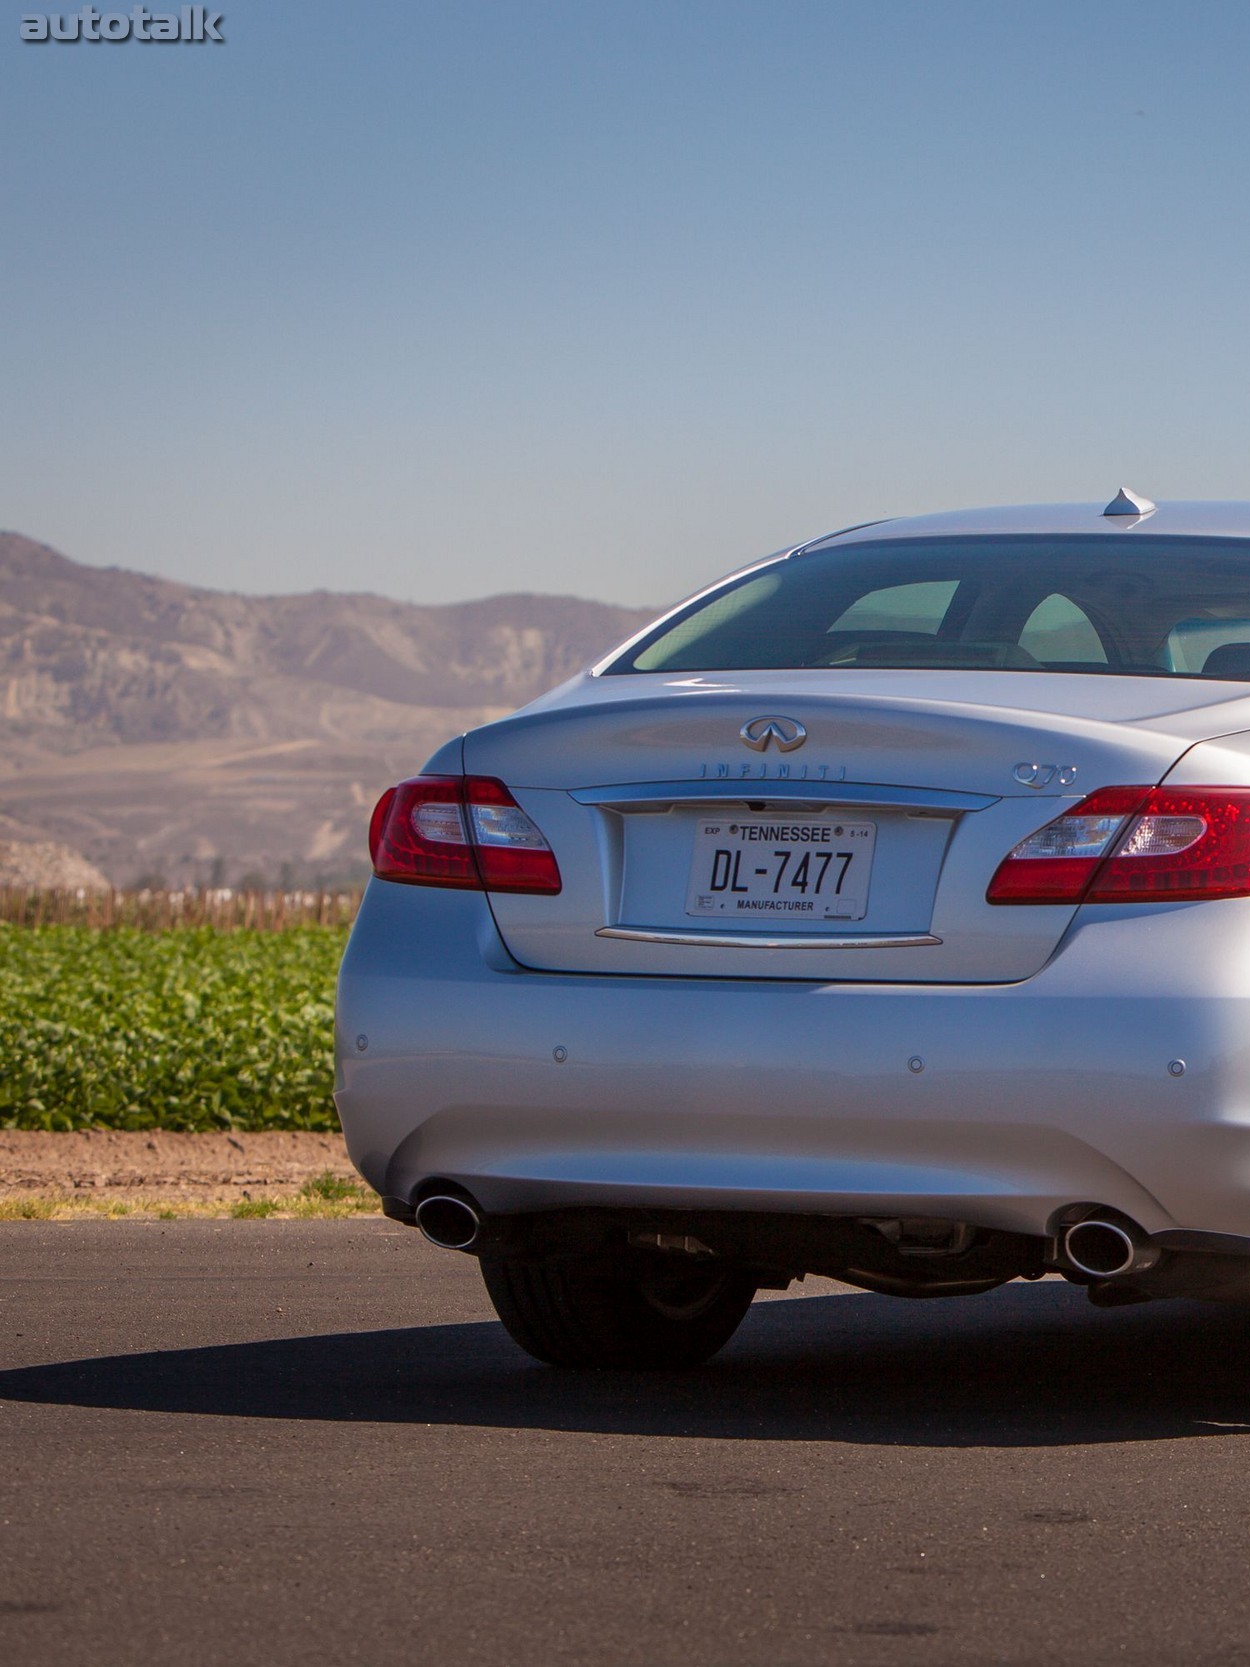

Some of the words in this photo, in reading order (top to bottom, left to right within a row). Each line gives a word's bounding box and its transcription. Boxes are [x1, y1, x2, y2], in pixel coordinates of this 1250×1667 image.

[699, 763, 846, 781] INFINITI
[1012, 762, 1077, 790] Q70
[704, 827, 721, 835] EXP
[740, 826, 831, 842] TENNESSEE
[710, 849, 853, 894] DL-7477
[737, 900, 814, 911] MANUFACTURER
